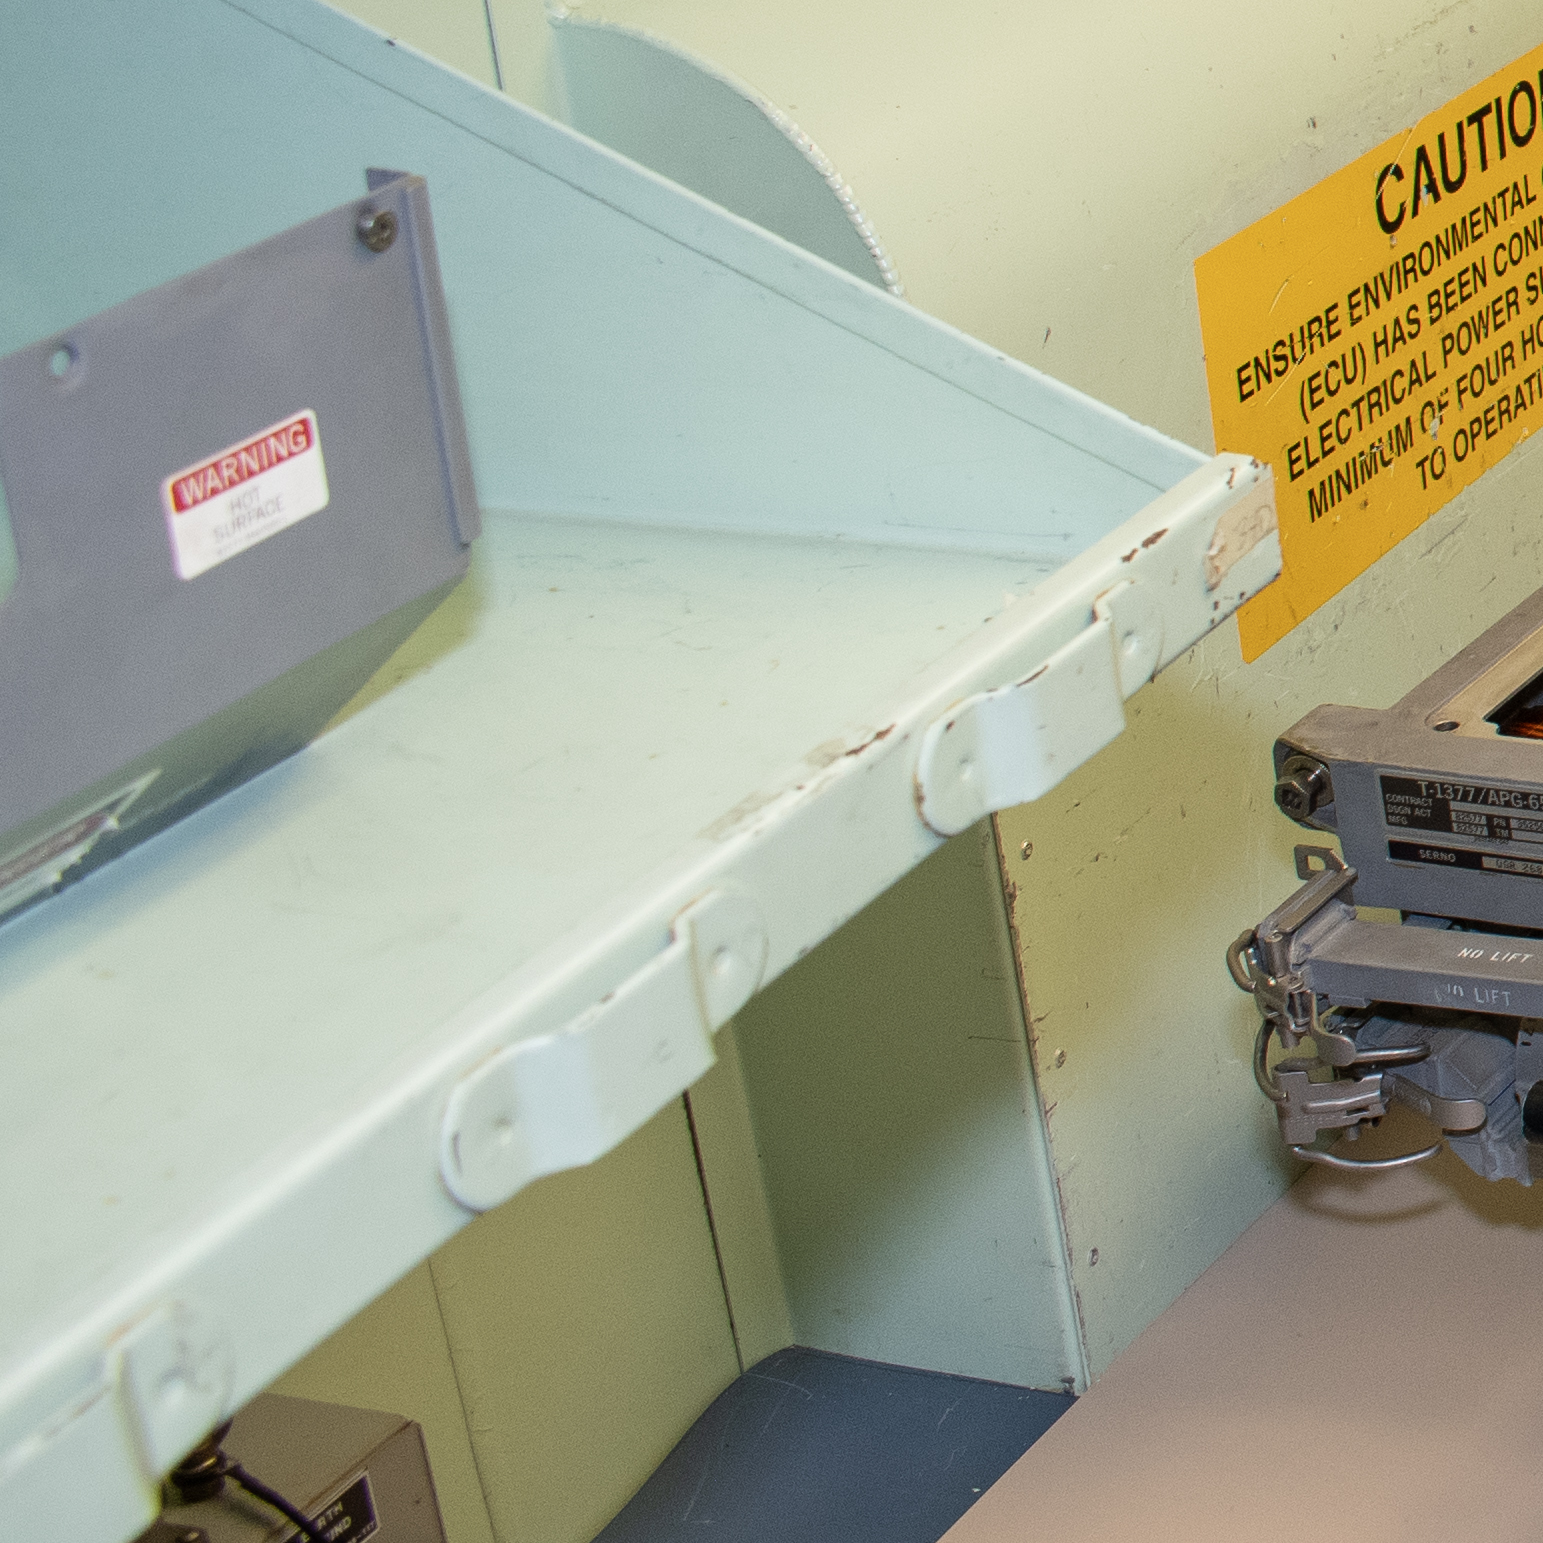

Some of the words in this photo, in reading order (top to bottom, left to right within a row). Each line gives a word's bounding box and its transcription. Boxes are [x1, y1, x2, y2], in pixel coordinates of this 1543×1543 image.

[1236, 314, 1342, 403] ENSURE
[1346, 190, 1536, 319] ENVIRONMENTAL
[1299, 341, 1367, 425] (ECU)
[1373, 304, 1423, 368] HAS
[1427, 269, 1489, 329] BEEN
[1286, 358, 1437, 482] ELECTRICAL
[1441, 280, 1521, 370] POWER
[1306, 423, 1415, 525] MINIMUM
[1420, 383, 1451, 438] OF
[1456, 336, 1517, 408] FOUR
[180, 421, 308, 506] WARNING
[1415, 448, 1447, 493] TO
[1385, 794, 1433, 807] CONTRACT
[1414, 808, 1432, 818] ACT
[1458, 947, 1484, 959] NO
[1490, 951, 1534, 964] LIFT
[1474, 987, 1511, 1007] LIFT
